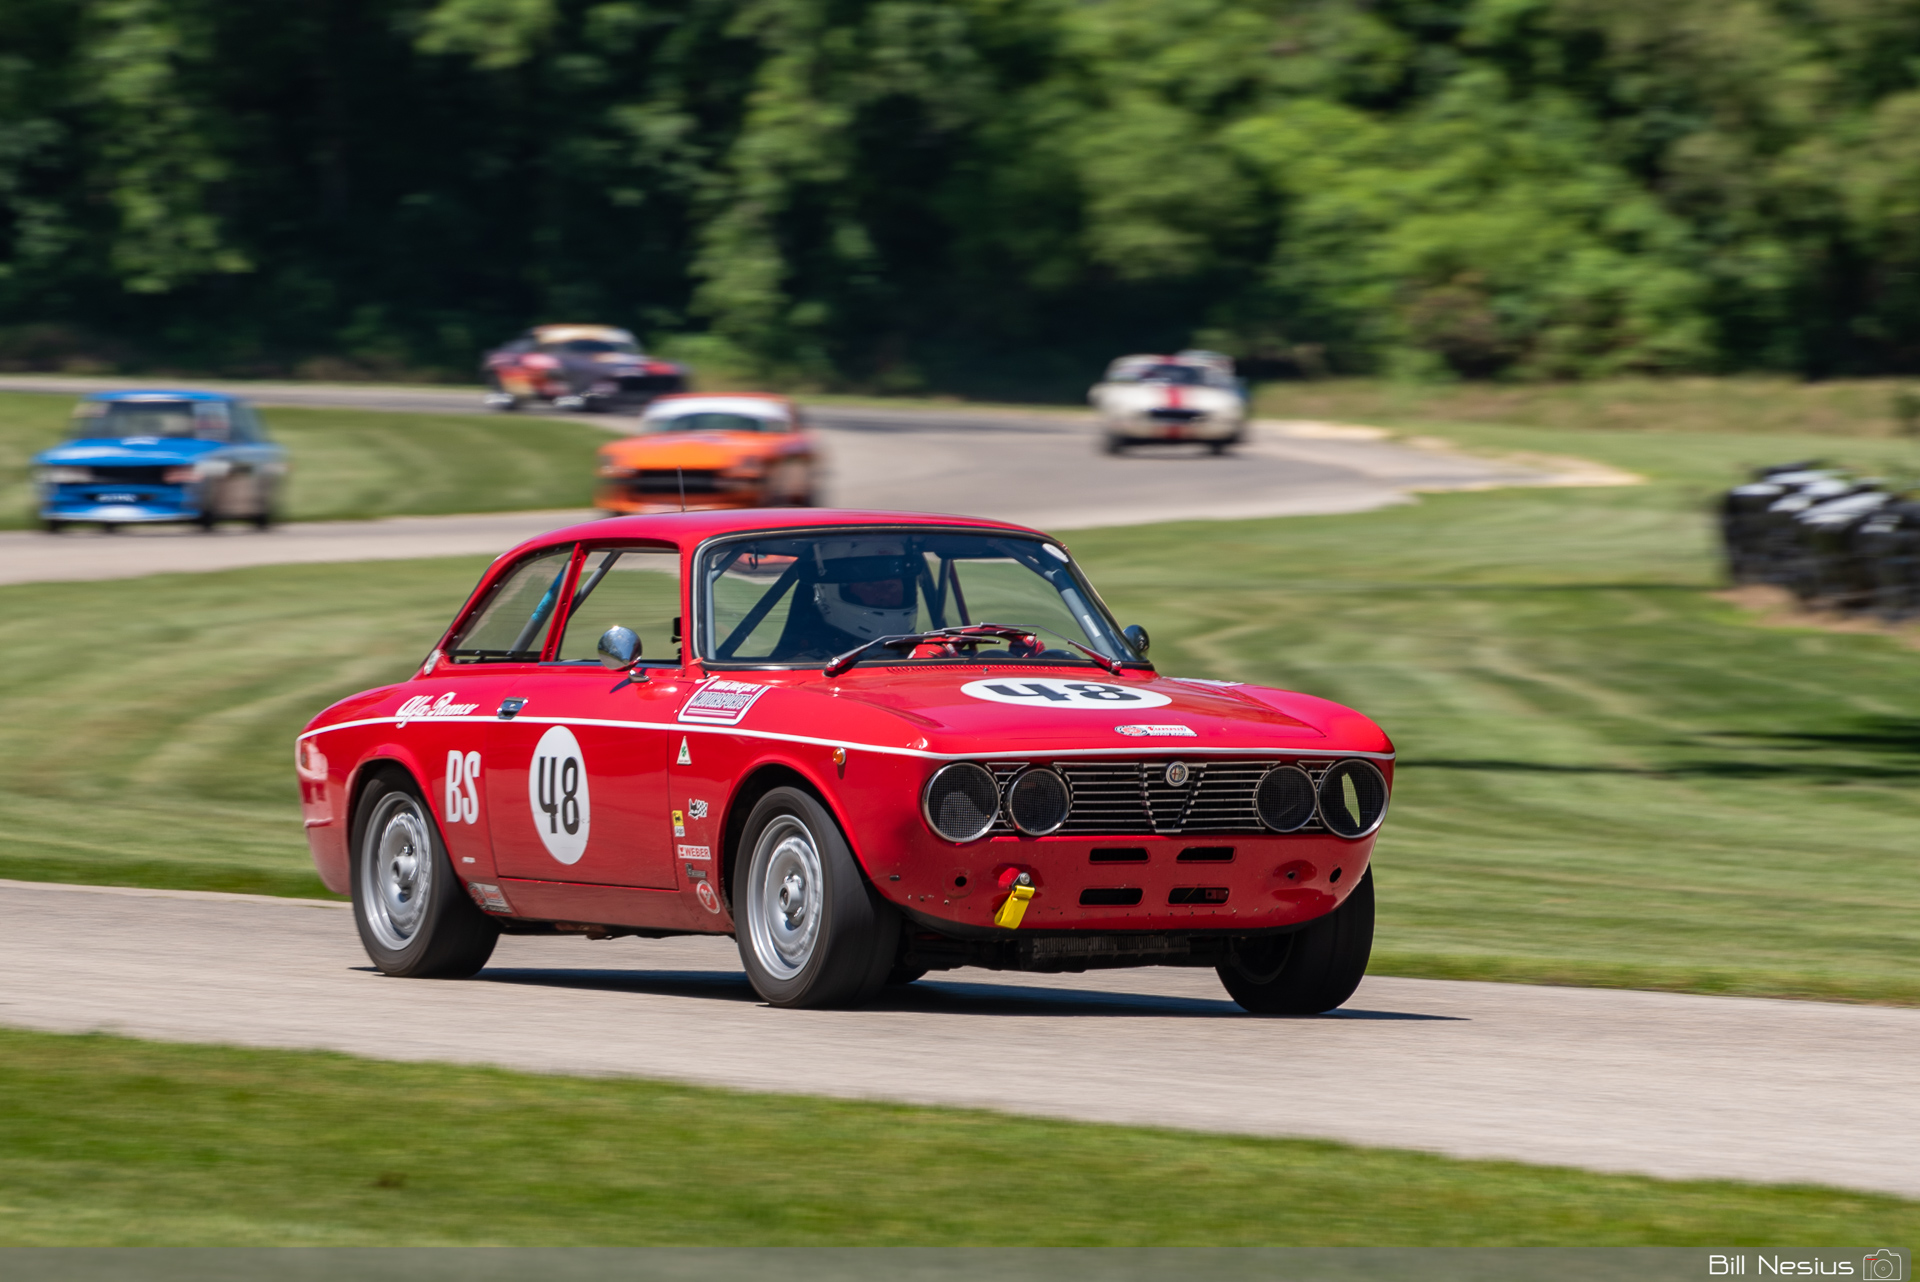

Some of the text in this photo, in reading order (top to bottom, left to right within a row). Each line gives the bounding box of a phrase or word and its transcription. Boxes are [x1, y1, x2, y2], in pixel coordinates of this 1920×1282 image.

[983, 684, 1142, 701] 48
[395, 695, 431, 729] Alfa
[445, 750, 481, 825] BS
[538, 756, 580, 835] 48
[685, 847, 710, 858] WEBER
